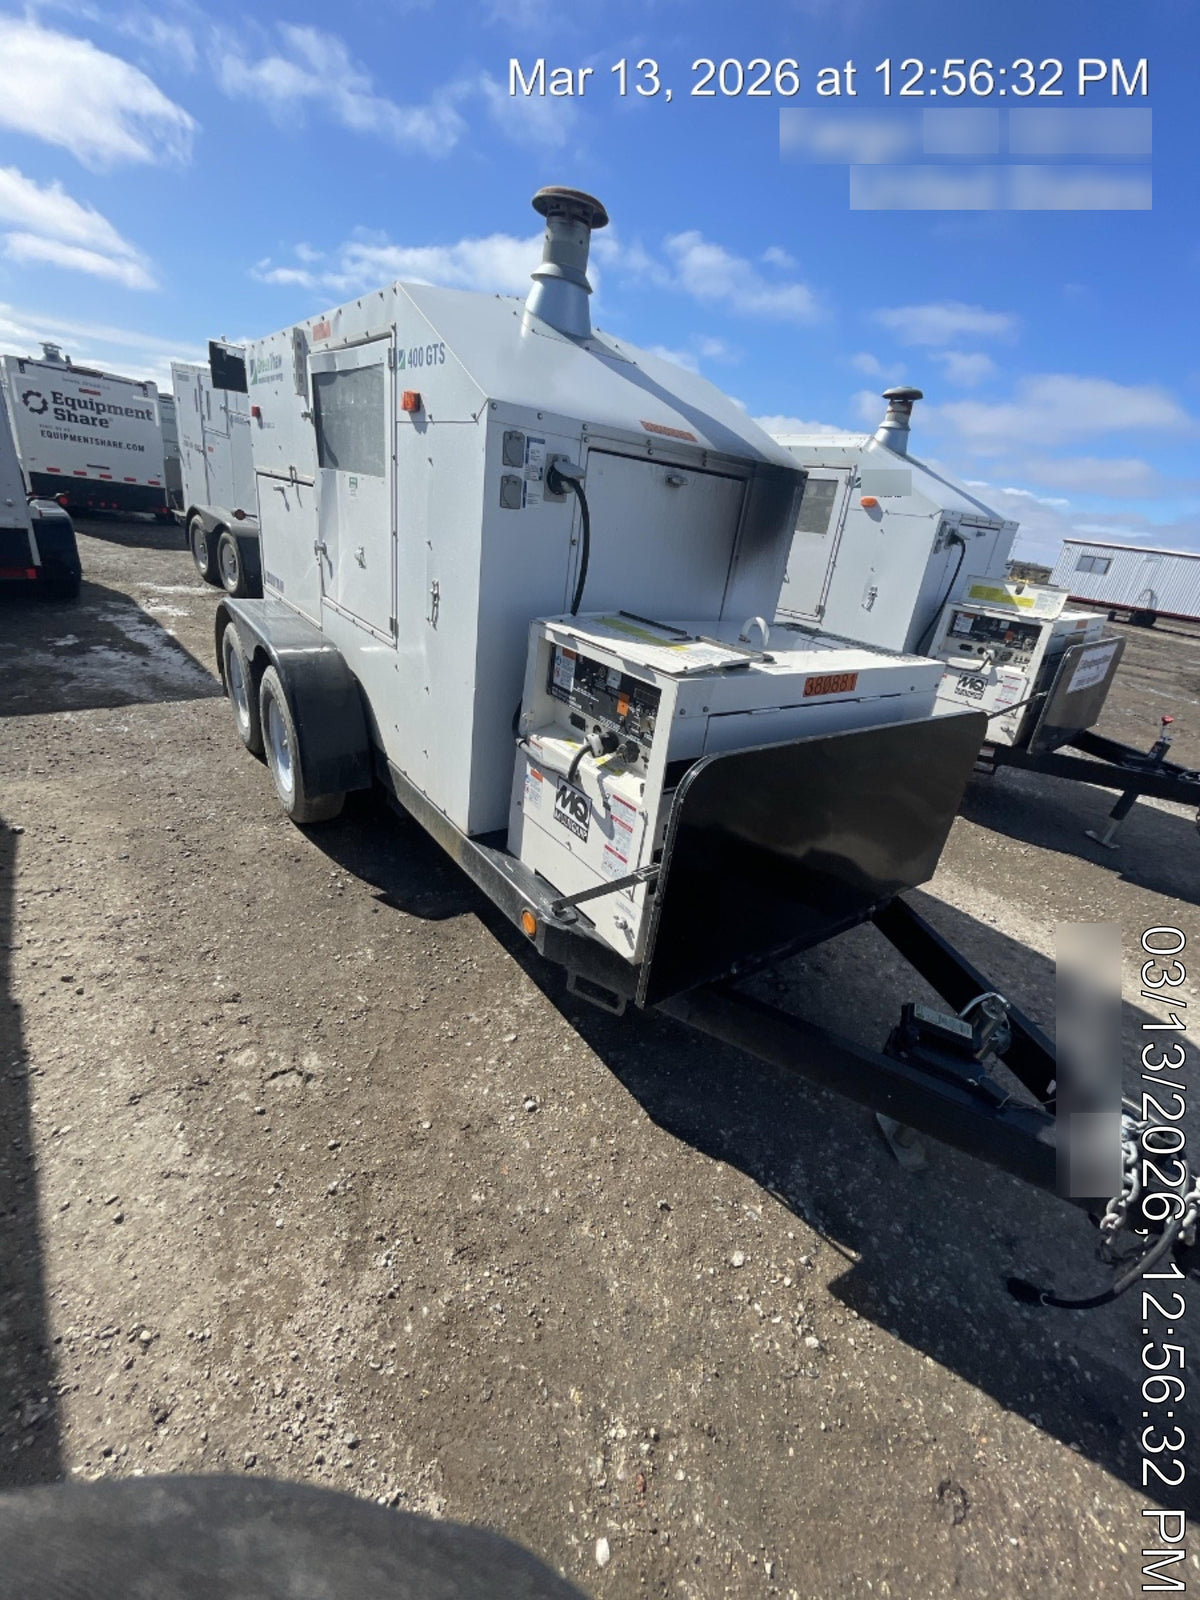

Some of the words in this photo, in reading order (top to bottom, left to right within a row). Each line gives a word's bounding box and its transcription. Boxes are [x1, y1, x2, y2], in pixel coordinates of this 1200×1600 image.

[408, 346, 424, 368] 400
[426, 342, 445, 366] GTS
[51, 390, 153, 421] Equipment
[53, 407, 110, 429] Share
[40, 429, 145, 453] EQUIPMENTSHARE.COM
[804, 673, 857, 697] 380881
[555, 784, 590, 830] MQ
